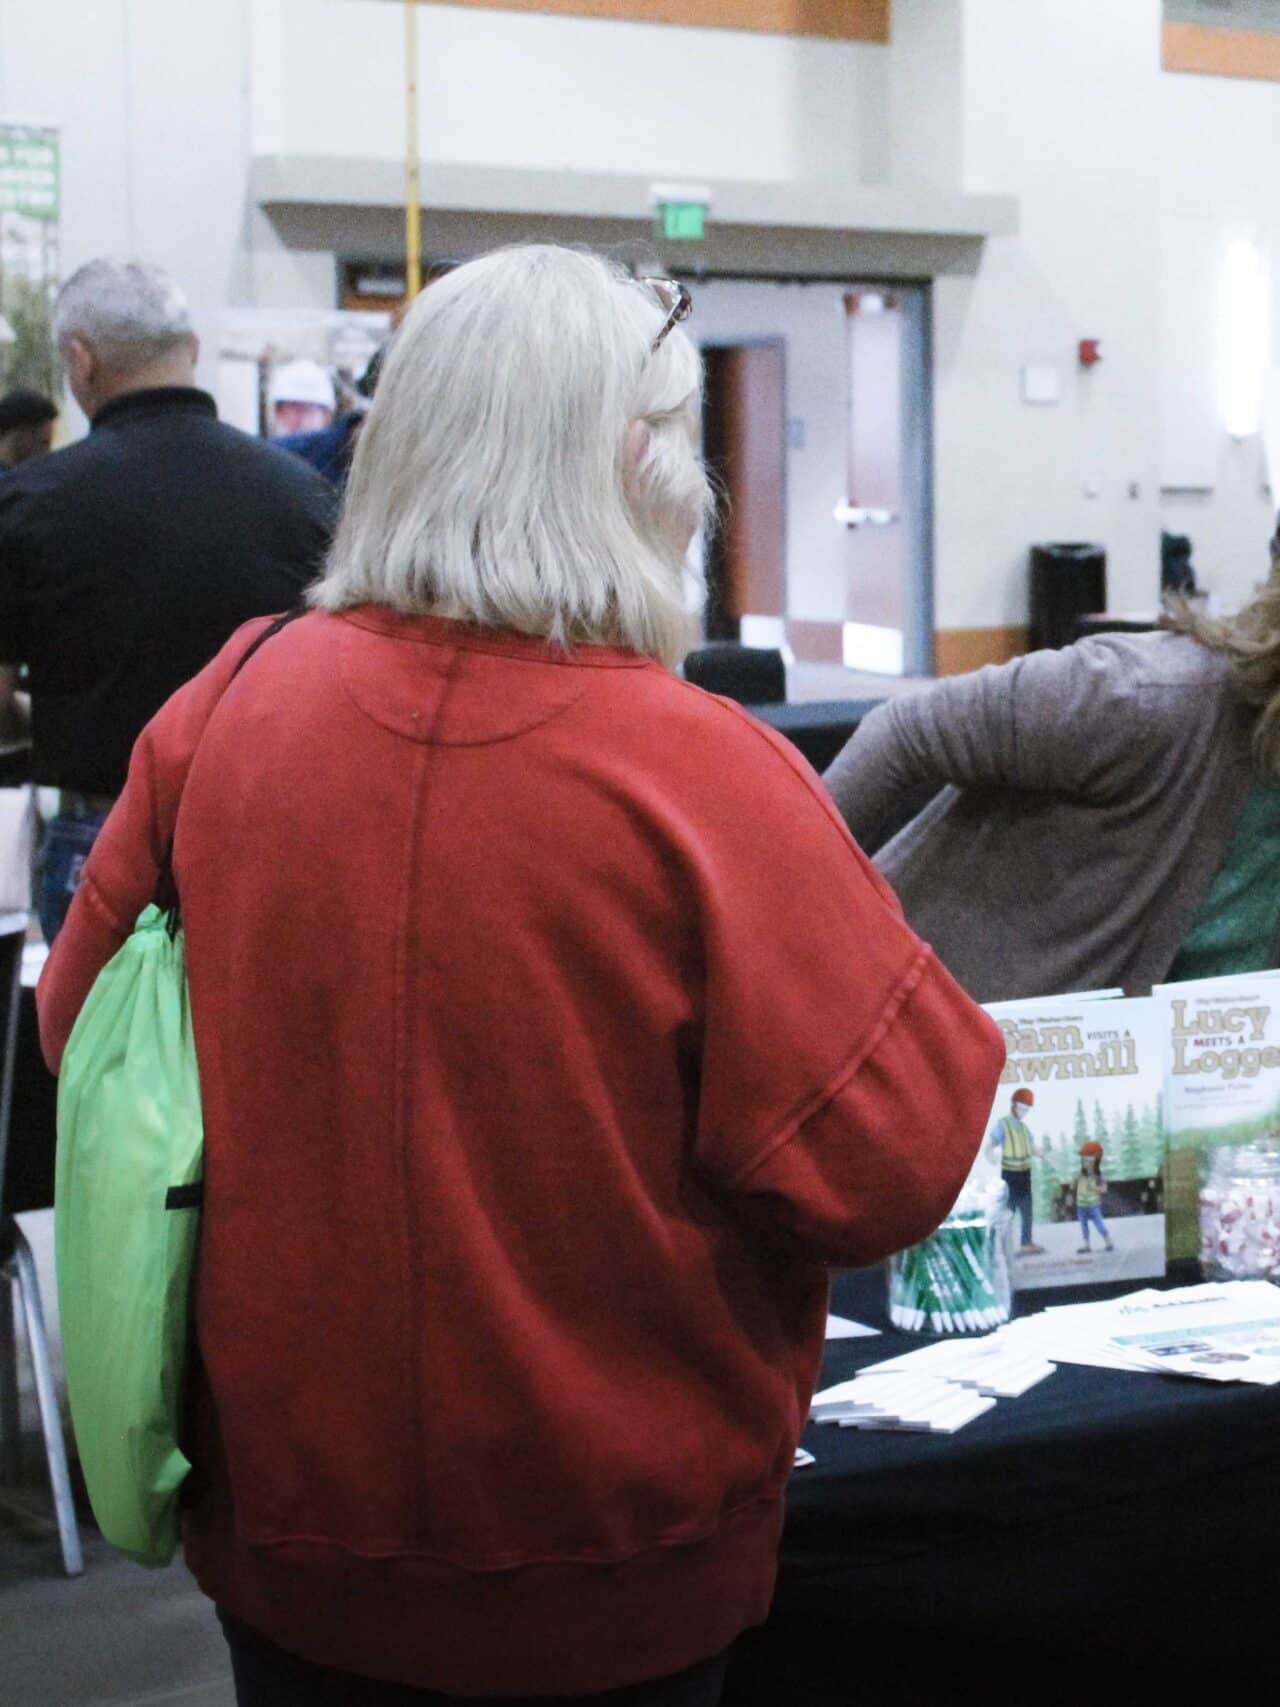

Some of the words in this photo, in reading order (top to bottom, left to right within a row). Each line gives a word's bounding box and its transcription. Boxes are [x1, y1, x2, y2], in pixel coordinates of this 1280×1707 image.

[1171, 1000, 1271, 1040] Lucy
[1087, 1030, 1119, 1040] VISITS
[1194, 1036, 1232, 1047] MEETS
[1238, 1035, 1245, 1044] A
[1000, 1038, 1138, 1084] awmill
